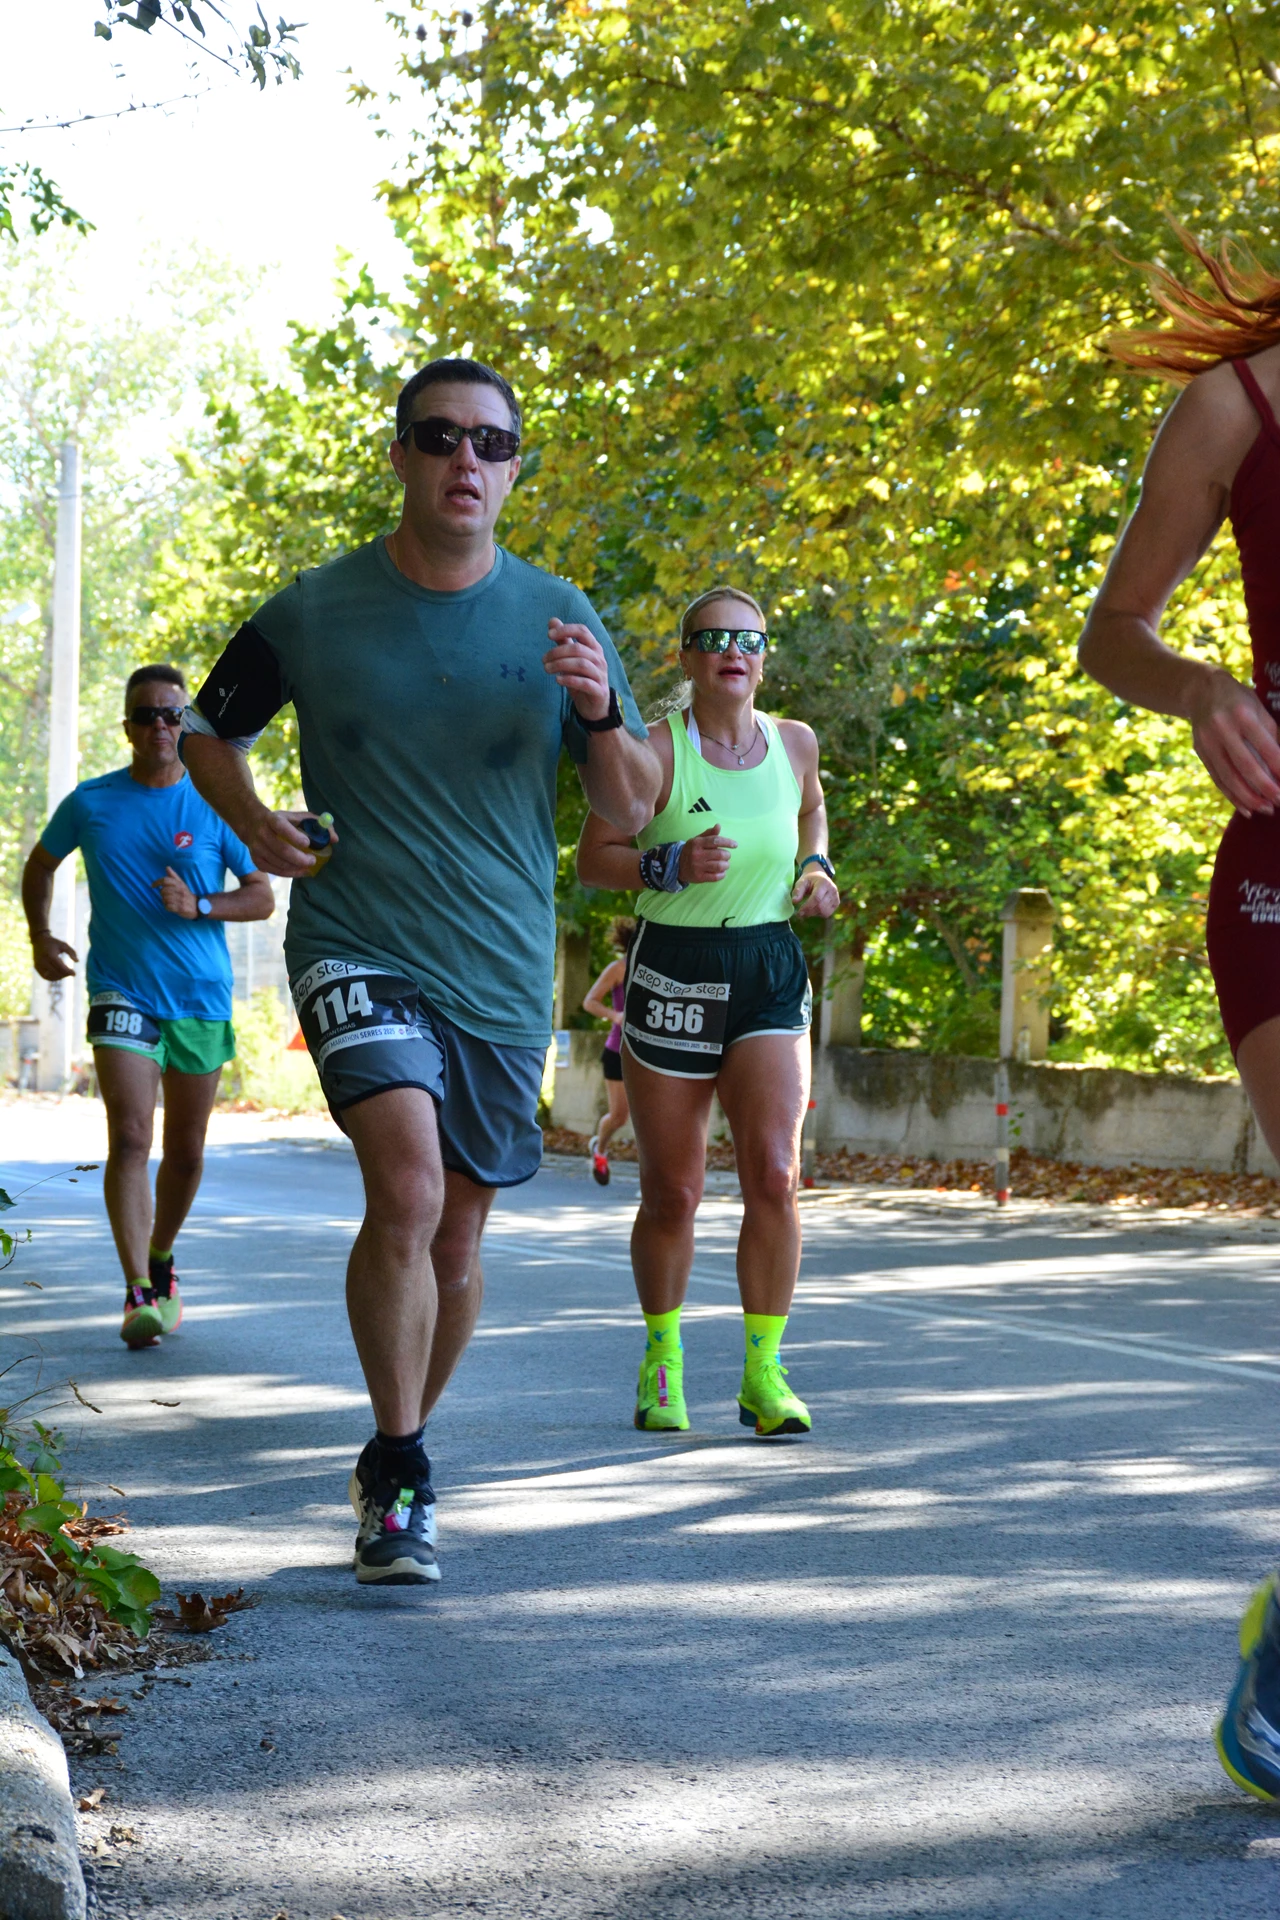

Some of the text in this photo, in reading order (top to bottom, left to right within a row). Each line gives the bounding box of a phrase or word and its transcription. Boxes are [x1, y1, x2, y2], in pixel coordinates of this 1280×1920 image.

[317, 962, 358, 979] step
[637, 968, 726, 998] step step step
[312, 981, 374, 1034] 114
[646, 999, 705, 1034] 356
[105, 1010, 143, 1035] 198
[330, 1031, 360, 1048] MARATHON
[359, 1027, 383, 1039] SERRES
[383, 1027, 396, 1036] 2025
[674, 1041, 690, 1049] SERRES
